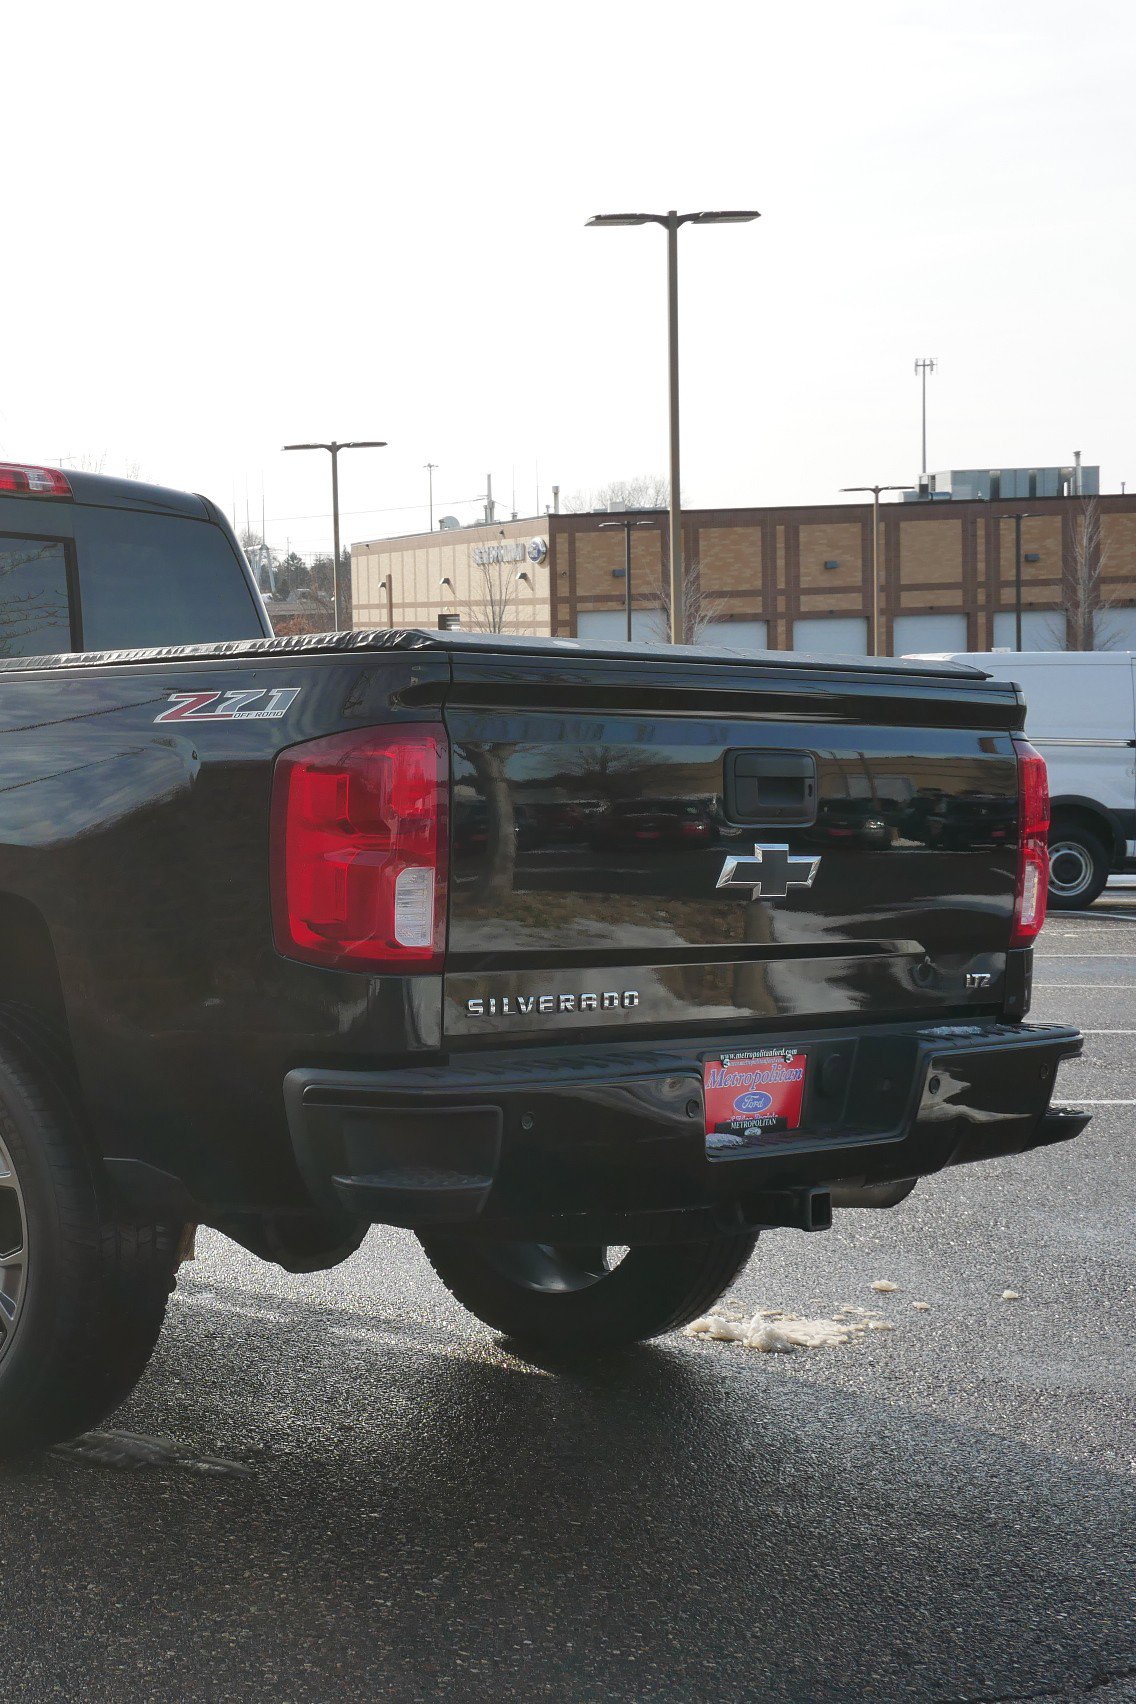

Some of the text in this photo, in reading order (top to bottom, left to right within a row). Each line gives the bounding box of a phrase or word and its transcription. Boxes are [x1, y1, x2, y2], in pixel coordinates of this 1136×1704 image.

[153, 688, 302, 724] Z71
[233, 710, 284, 719] OFF ROAD
[966, 973, 991, 987] LTZ
[465, 990, 639, 1018] SILVERADO
[720, 1048, 798, 1060] www.metropolitanford.com
[705, 1064, 803, 1091] Metropolitan
[741, 1095, 764, 1109] Ford
[730, 1118, 777, 1129] METROPOLITAN
